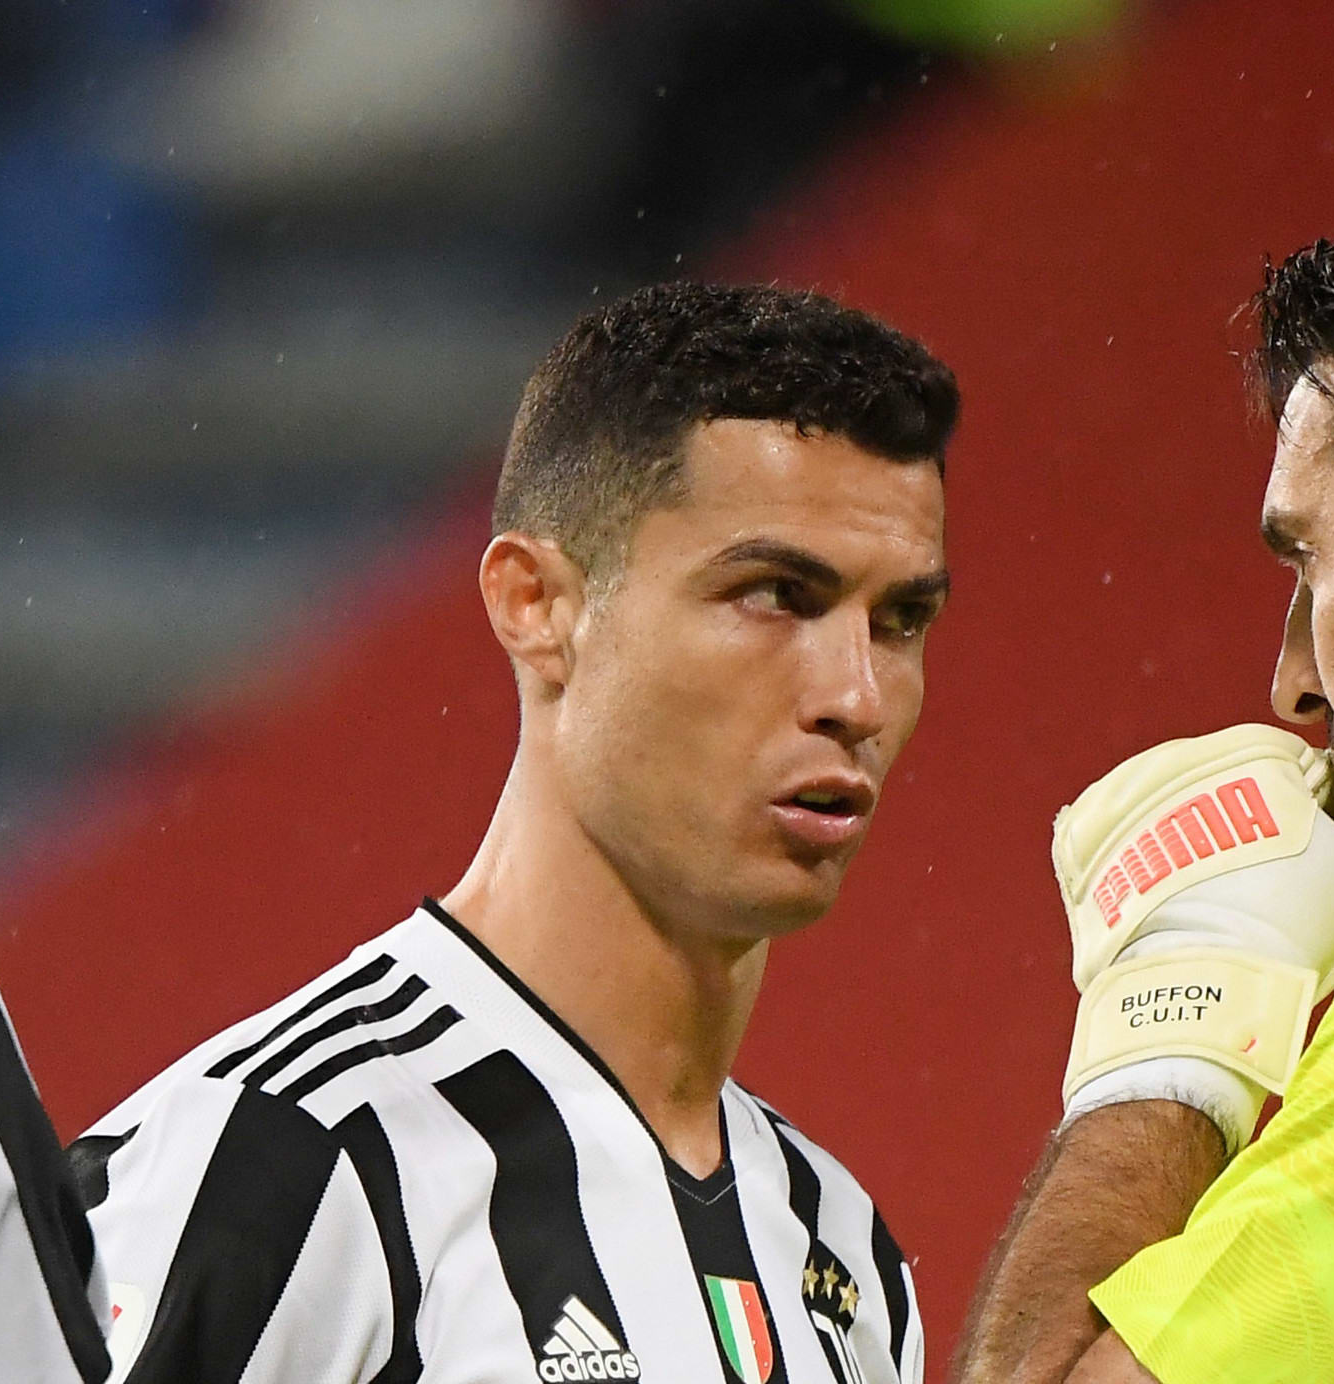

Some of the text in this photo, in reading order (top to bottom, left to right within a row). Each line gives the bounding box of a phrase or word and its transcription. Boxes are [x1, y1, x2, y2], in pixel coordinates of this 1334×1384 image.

[1093, 776, 1280, 929] PUMA
[1121, 985, 1222, 1013] BUFFON
[1129, 1005, 1208, 1029] C.U.I.T
[539, 1347, 641, 1382] adidas
